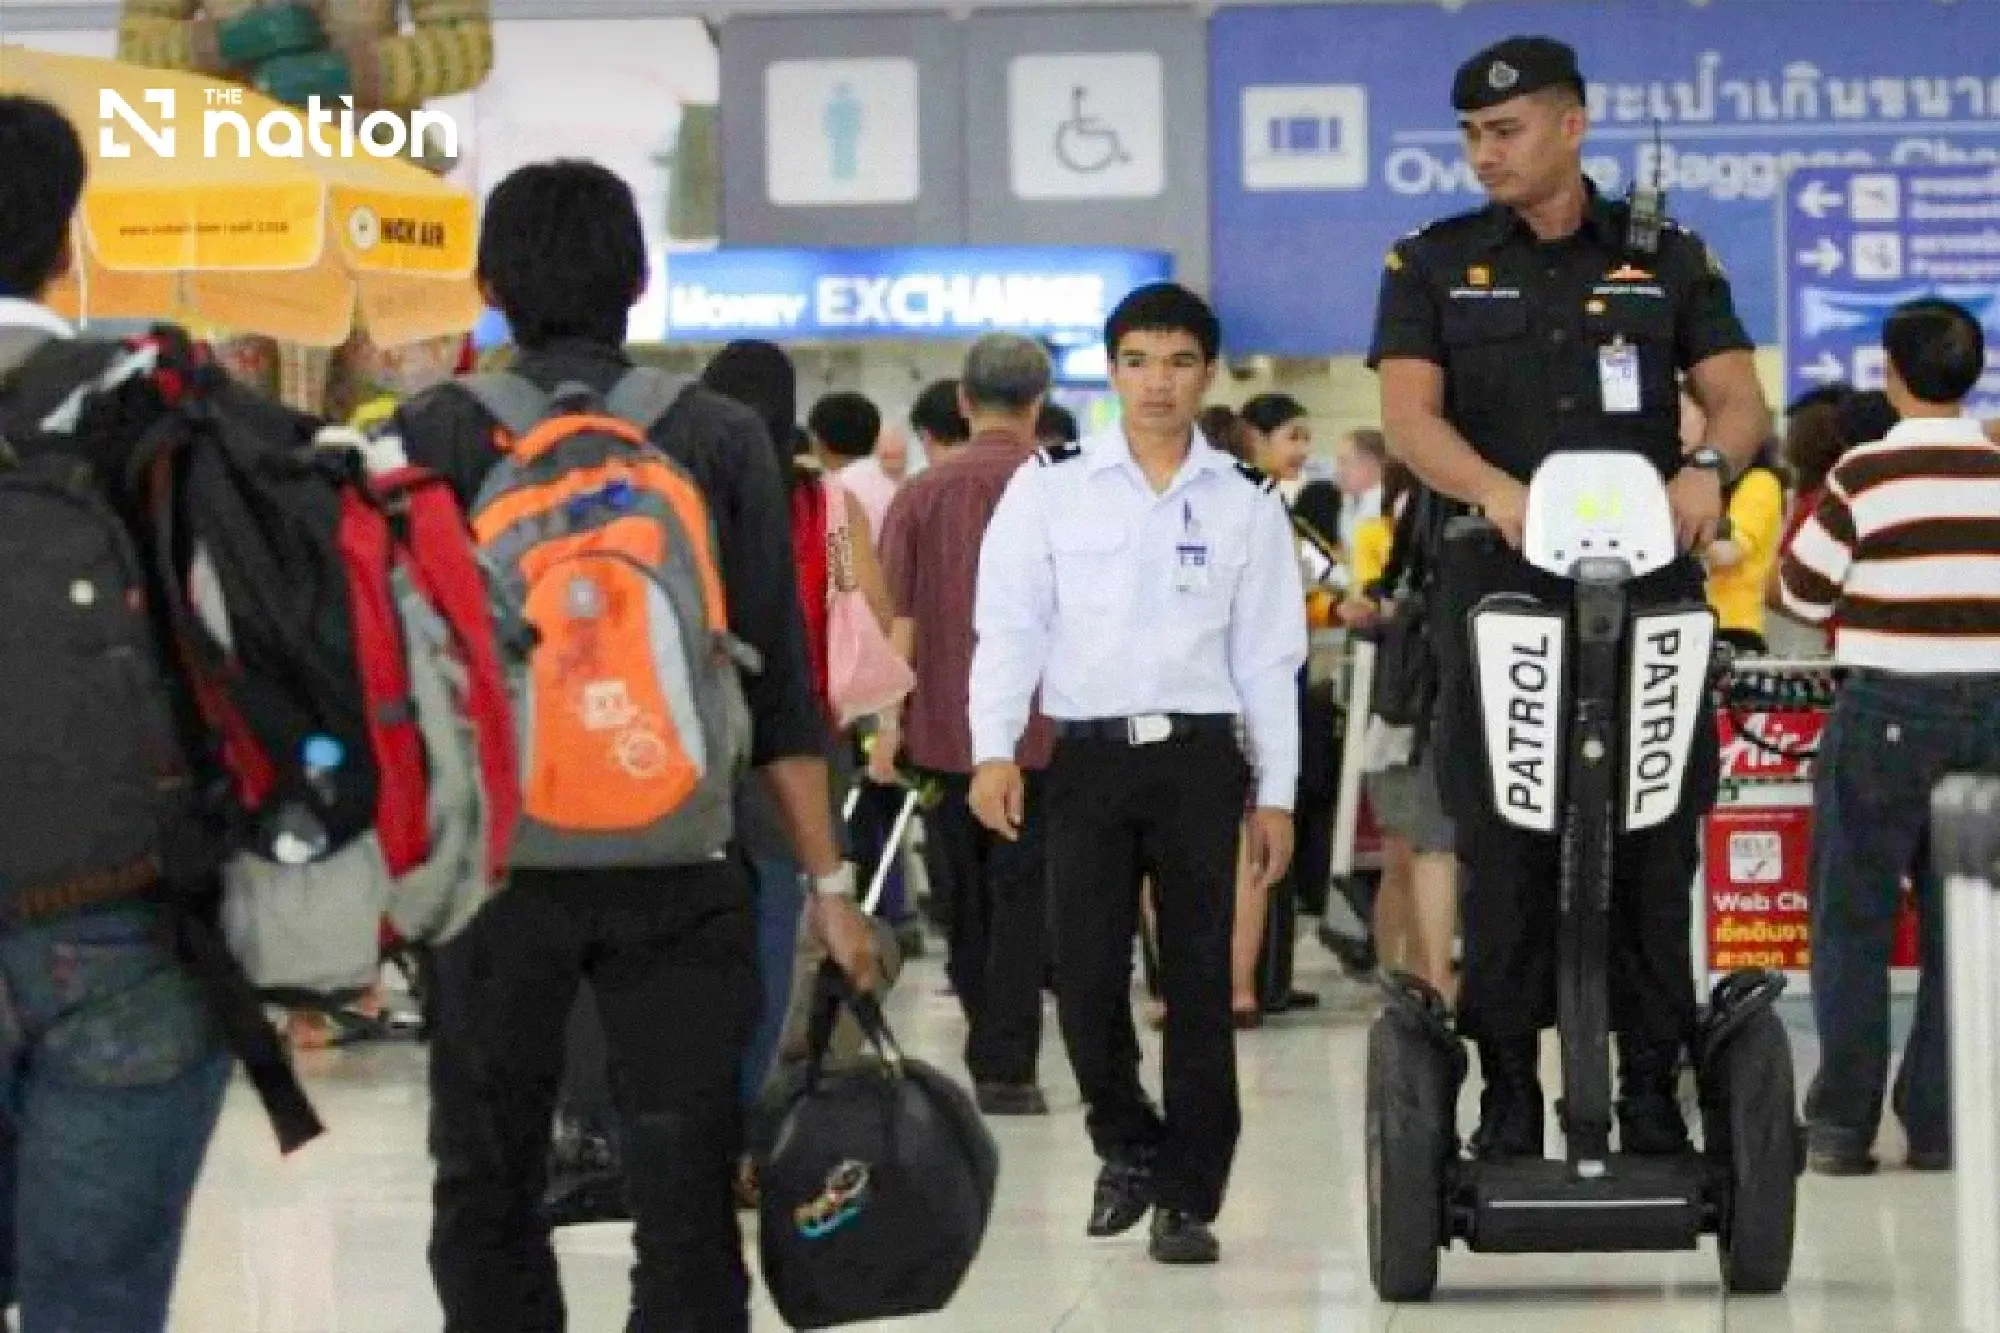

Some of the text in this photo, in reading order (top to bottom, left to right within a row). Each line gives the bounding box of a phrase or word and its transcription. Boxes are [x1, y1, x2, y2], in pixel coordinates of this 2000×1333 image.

[1508, 633, 1548, 814] PATROL
[1634, 628, 1681, 814] PATROL
[1713, 891, 1808, 911] Web Ch
